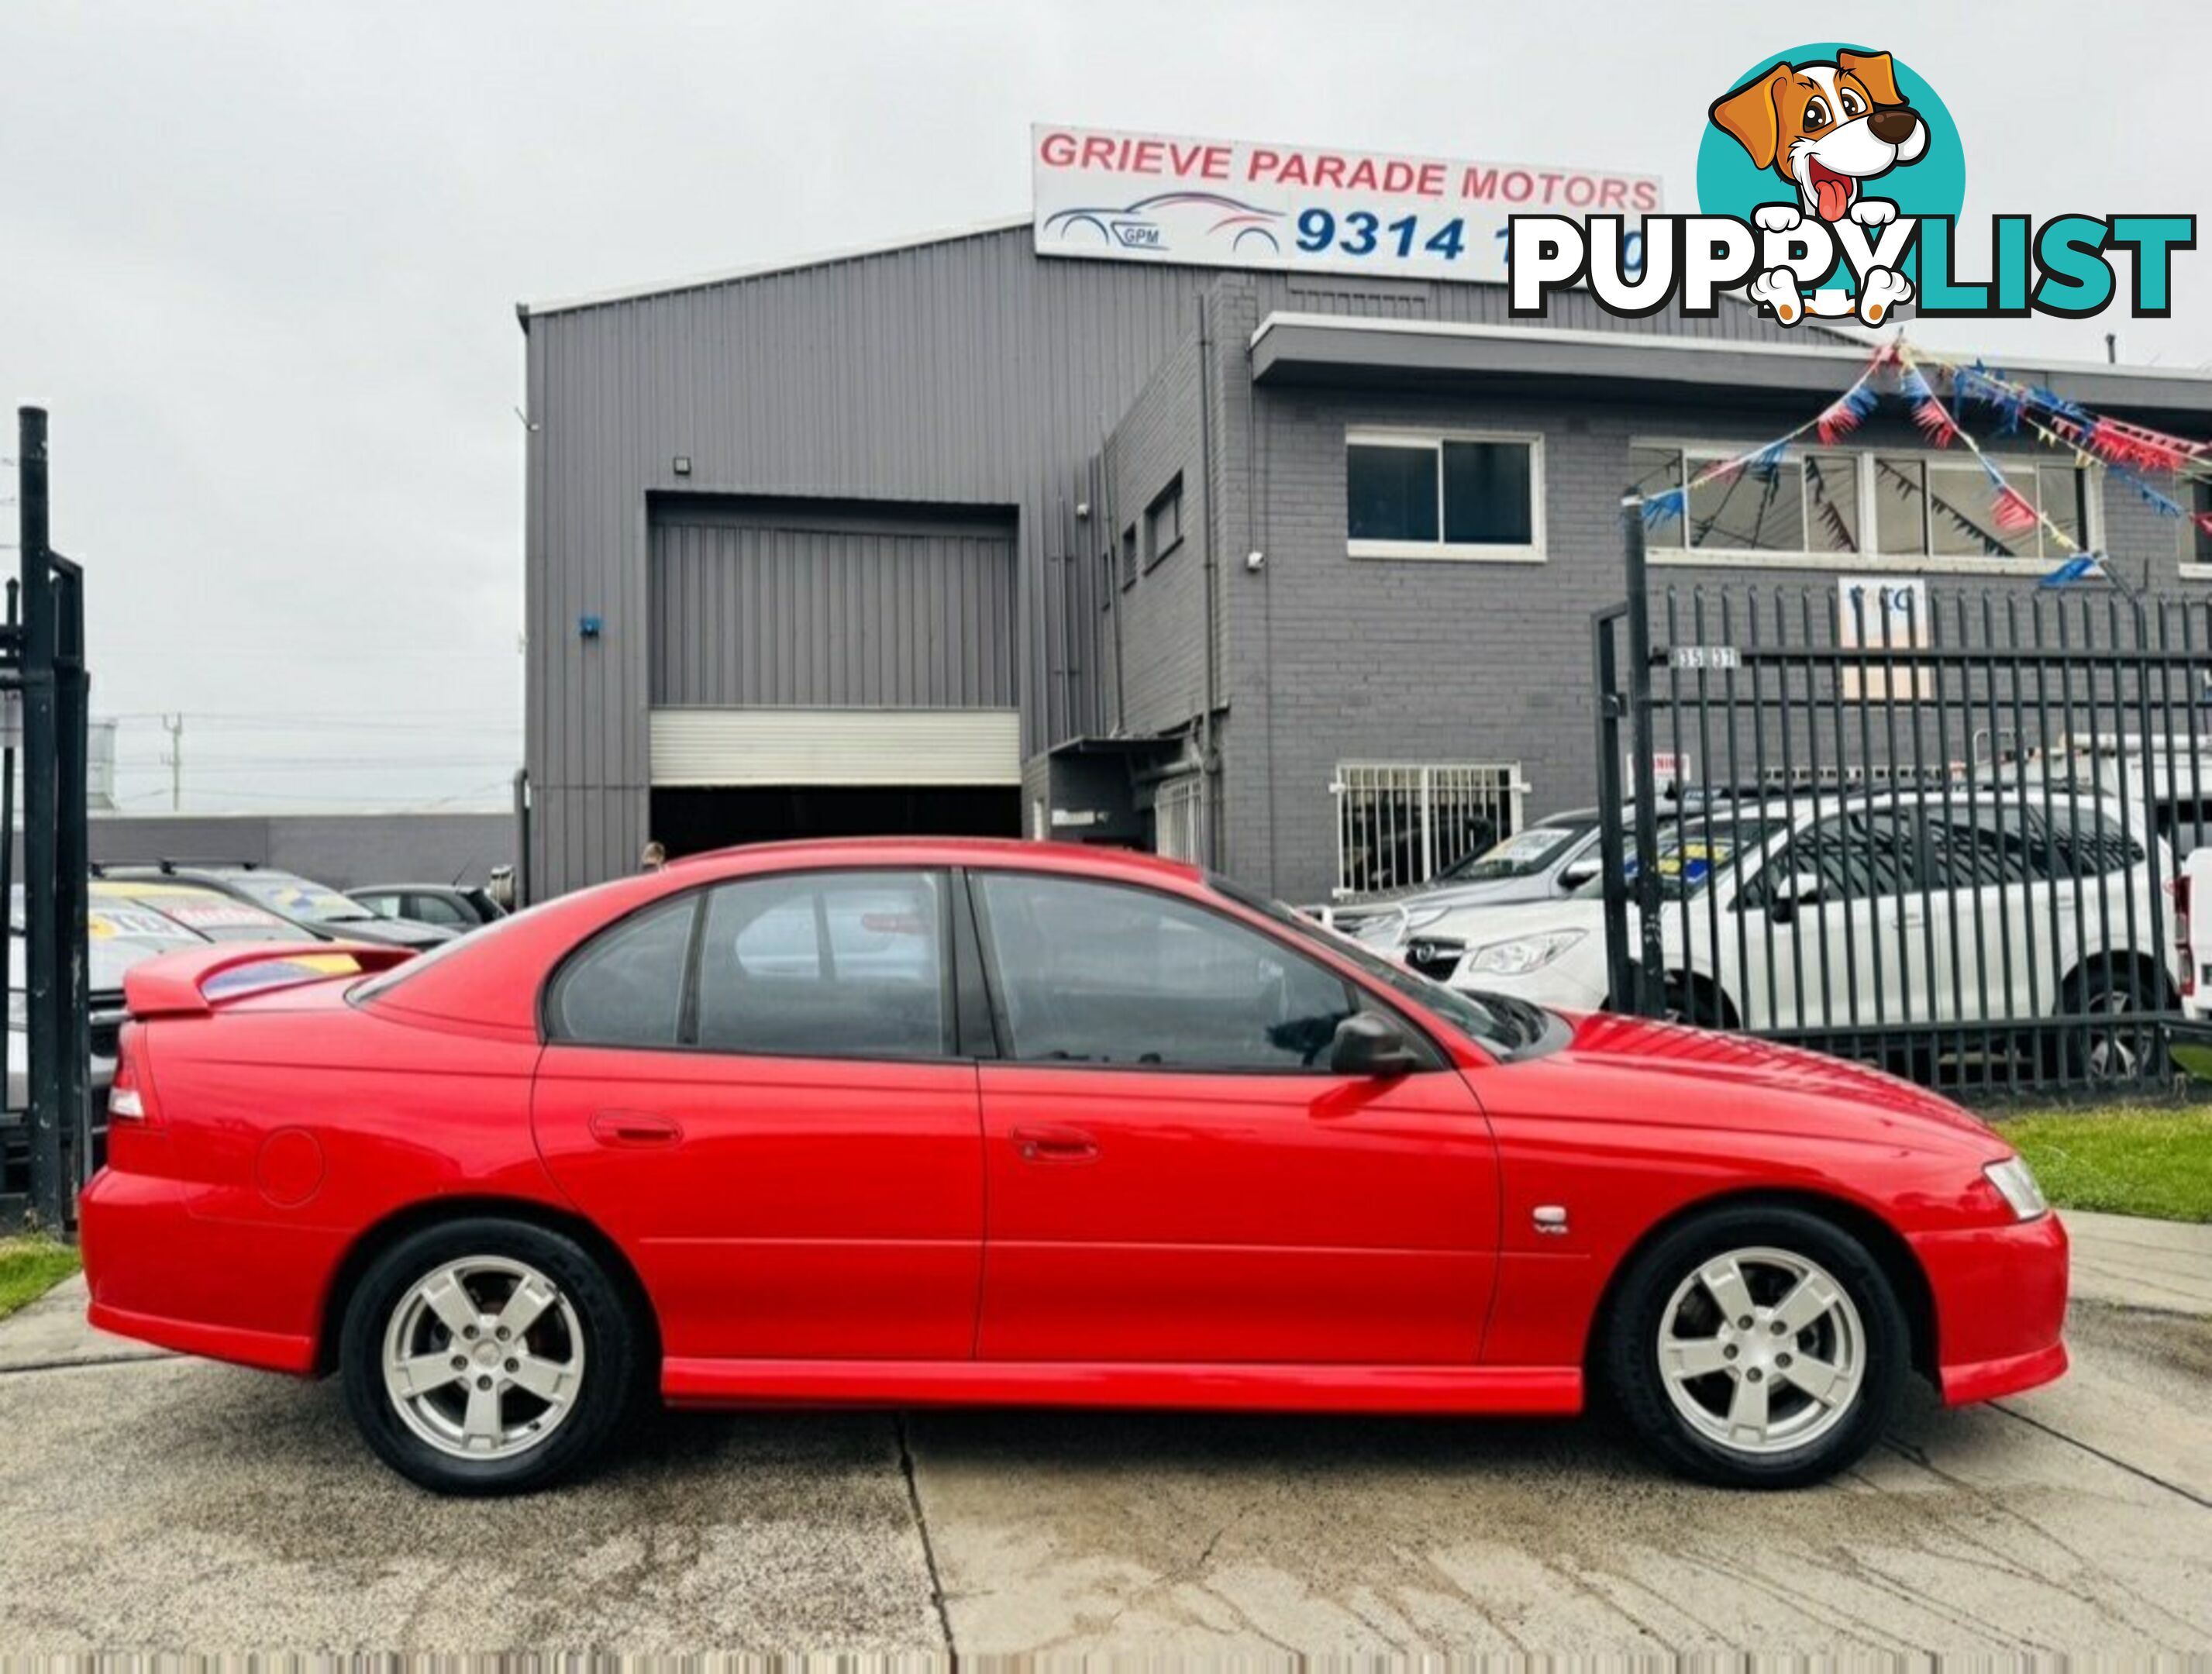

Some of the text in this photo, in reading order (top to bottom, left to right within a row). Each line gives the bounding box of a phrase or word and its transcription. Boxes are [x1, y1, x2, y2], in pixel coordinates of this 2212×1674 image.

[1041, 133, 1657, 211] GRIEVE PARADE MOTORS
[1125, 228, 1159, 243] GPM
[1296, 208, 1465, 260] 9314
